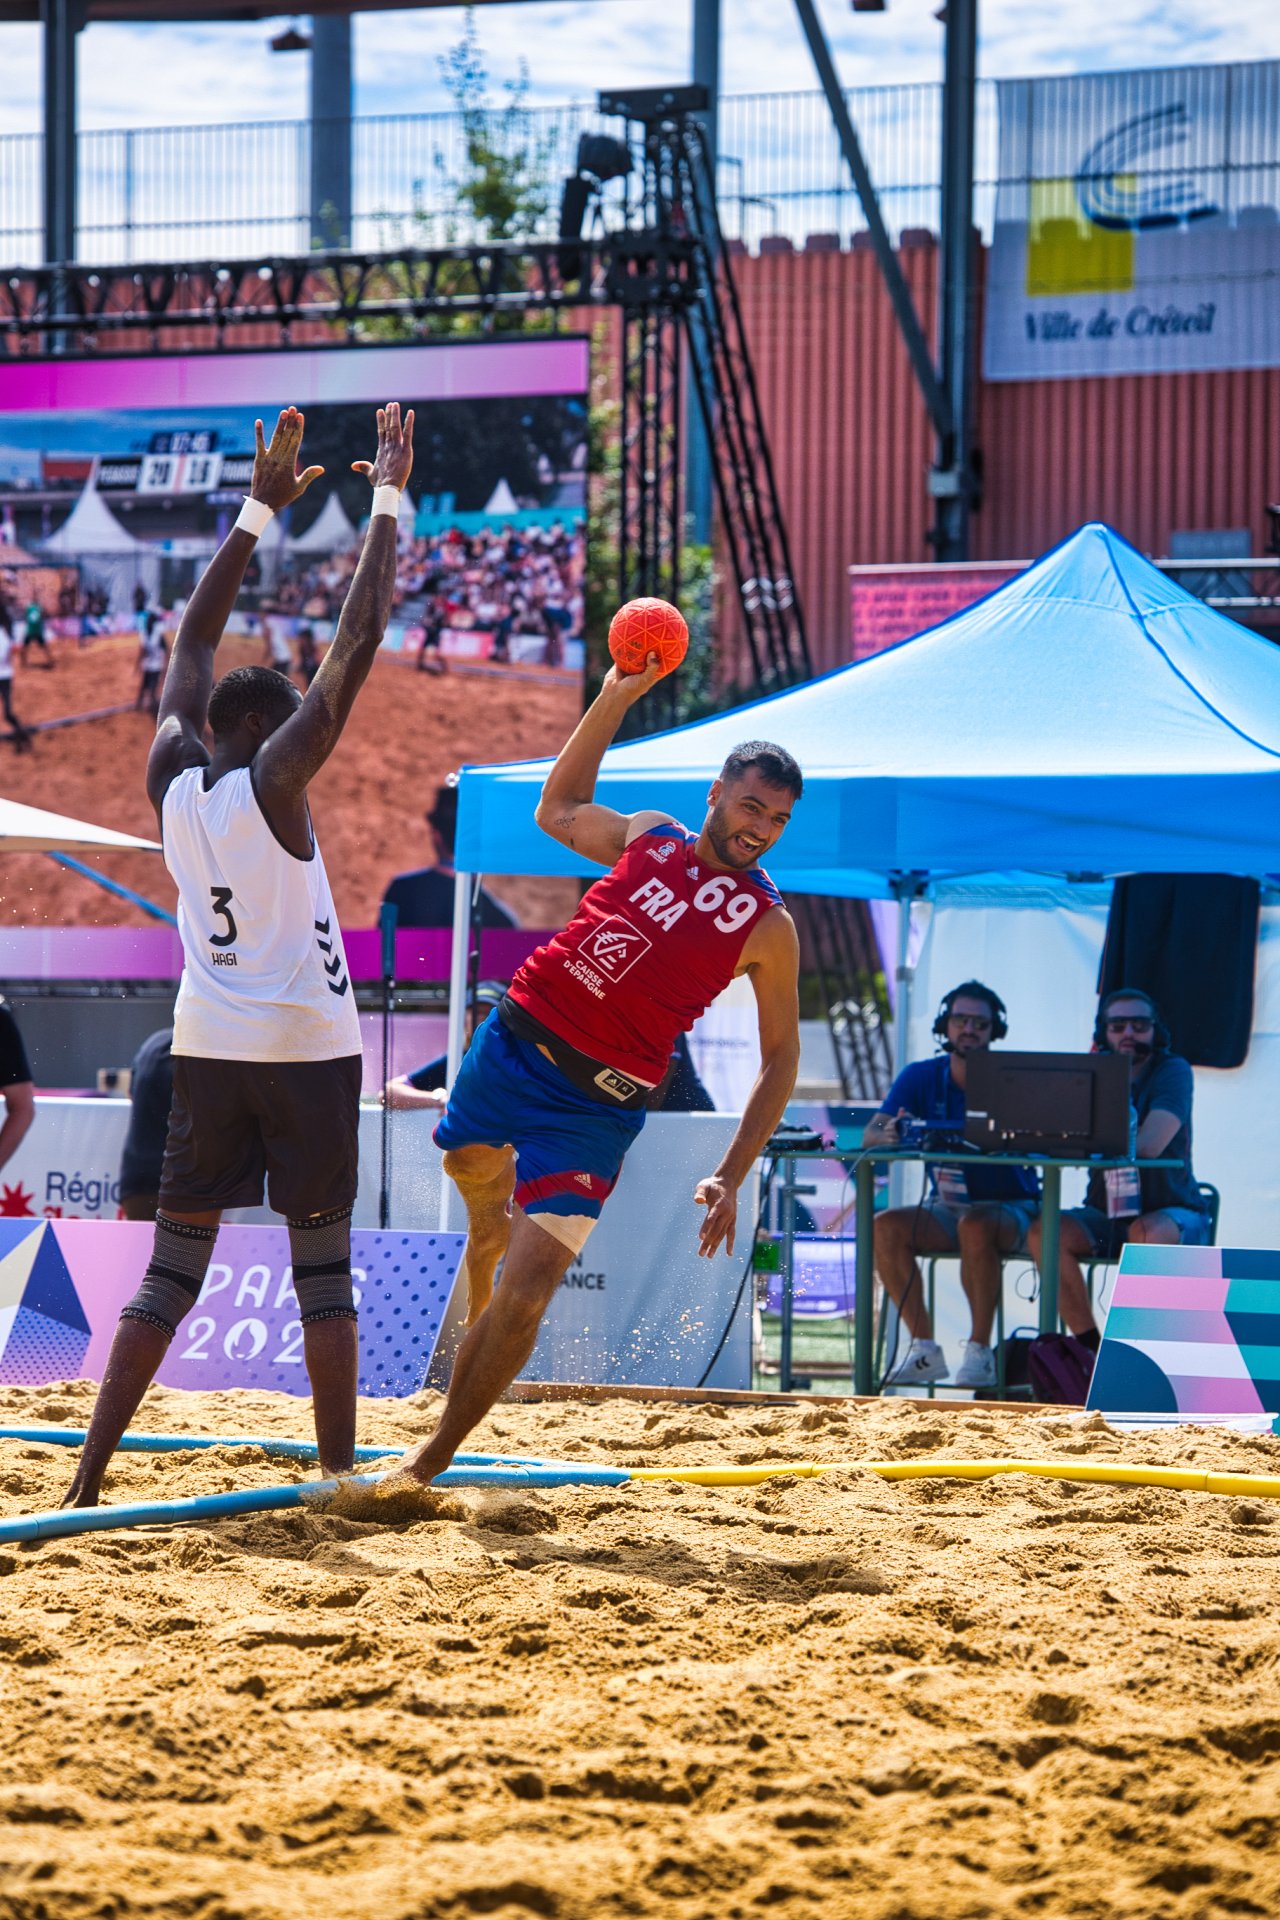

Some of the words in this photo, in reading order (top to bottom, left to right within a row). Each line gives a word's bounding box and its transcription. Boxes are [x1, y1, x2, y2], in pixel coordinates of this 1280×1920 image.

[1025, 311, 1082, 341] Ville
[1086, 308, 1120, 338] de
[1125, 301, 1216, 336] Créteil
[208, 886, 238, 947] 3
[629, 876, 689, 932] FRA
[693, 876, 758, 933] 69
[211, 952, 238, 966] HAGI
[563, 959, 606, 1000] D'EPARGNE
[575, 959, 605, 988] CAISSE
[46, 1171, 120, 1211] Régio
[179, 1316, 304, 1364] 202
